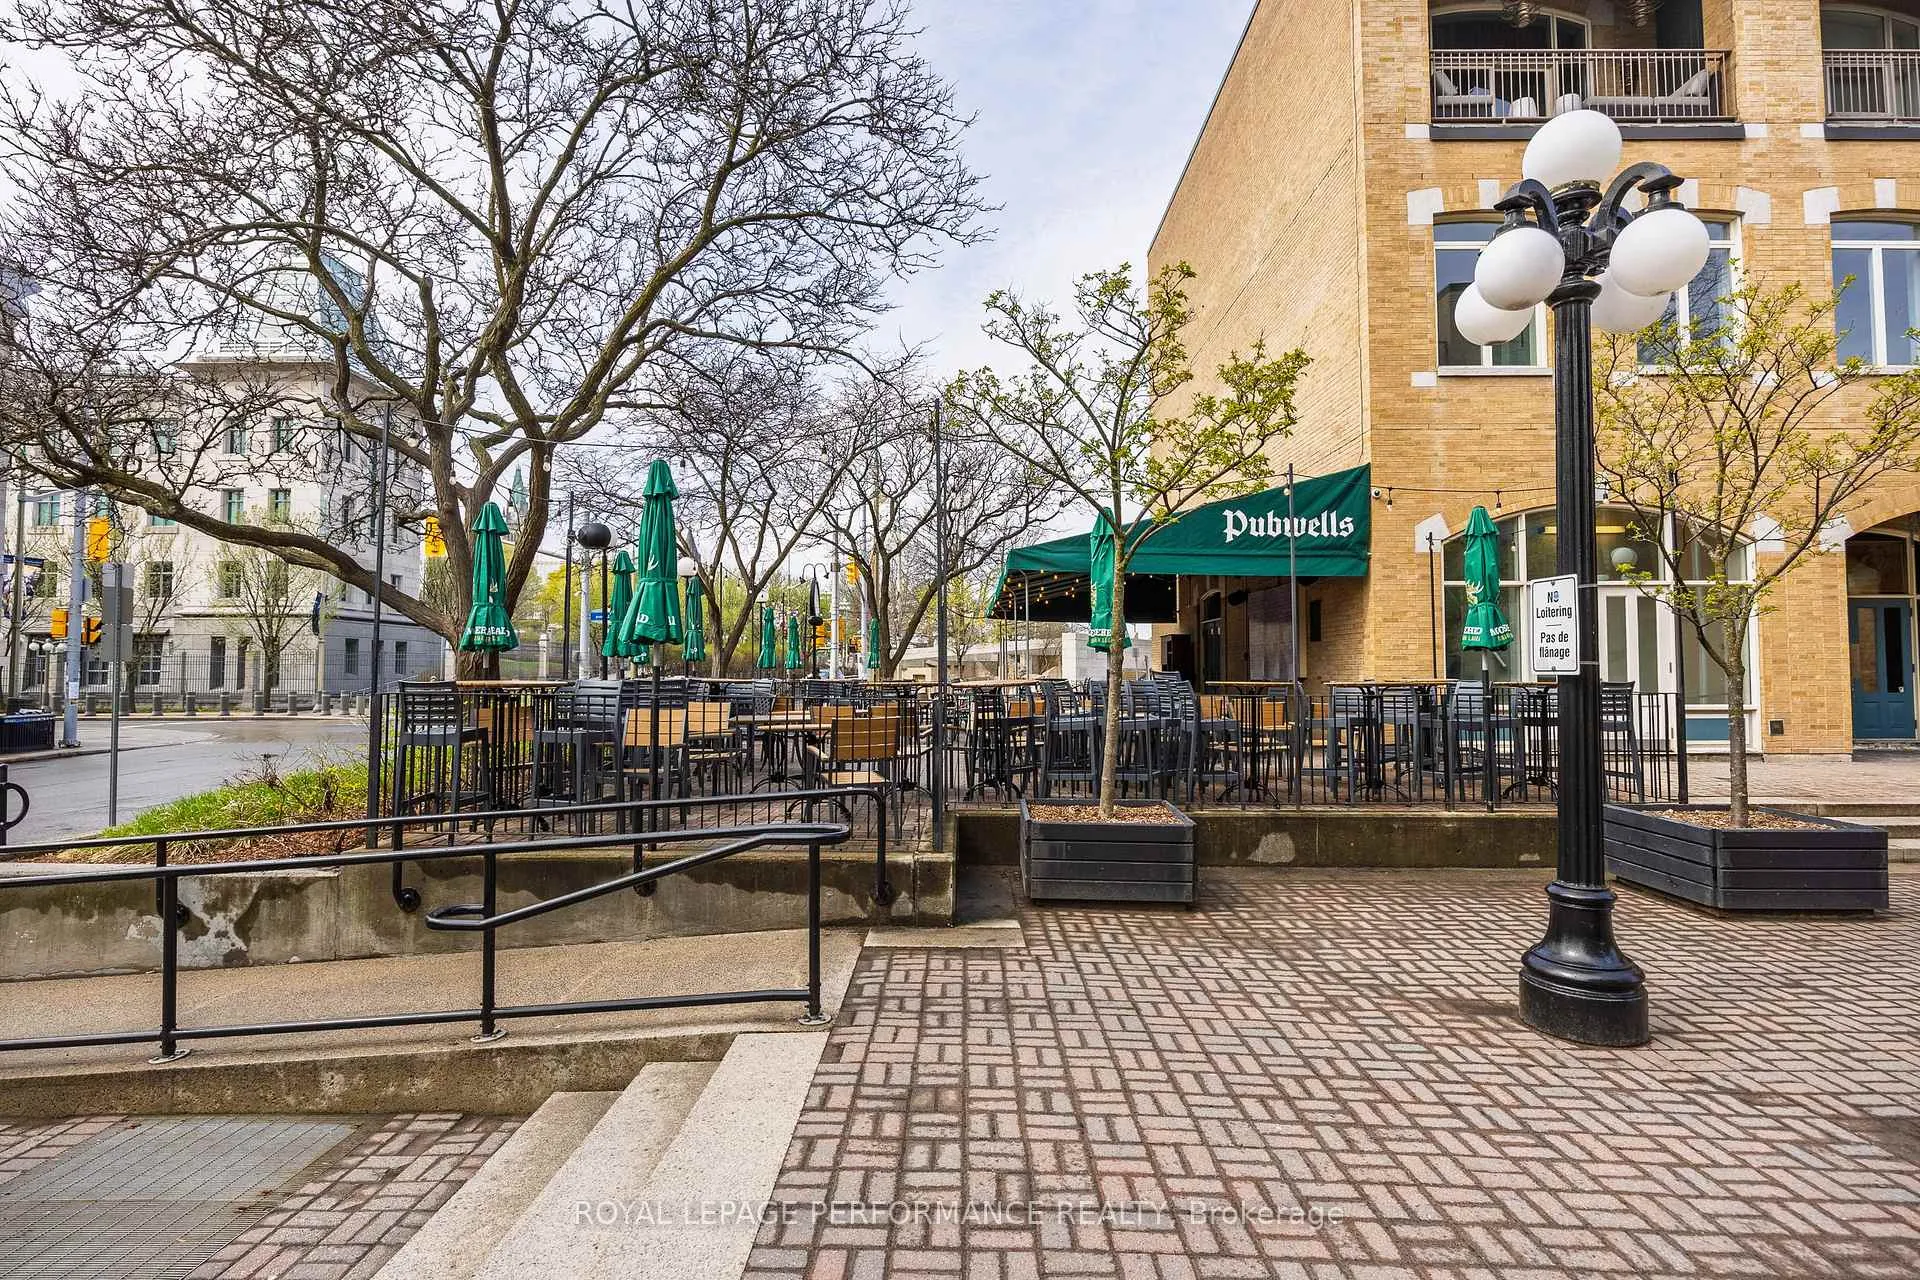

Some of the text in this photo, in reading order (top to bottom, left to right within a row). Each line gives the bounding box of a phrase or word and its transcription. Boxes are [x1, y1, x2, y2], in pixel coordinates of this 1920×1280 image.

[1222, 509, 1355, 543] Pubwells
[1536, 606, 1573, 619] Loitering
[1540, 631, 1569, 643] Pas de
[1539, 646, 1570, 659] flânage
